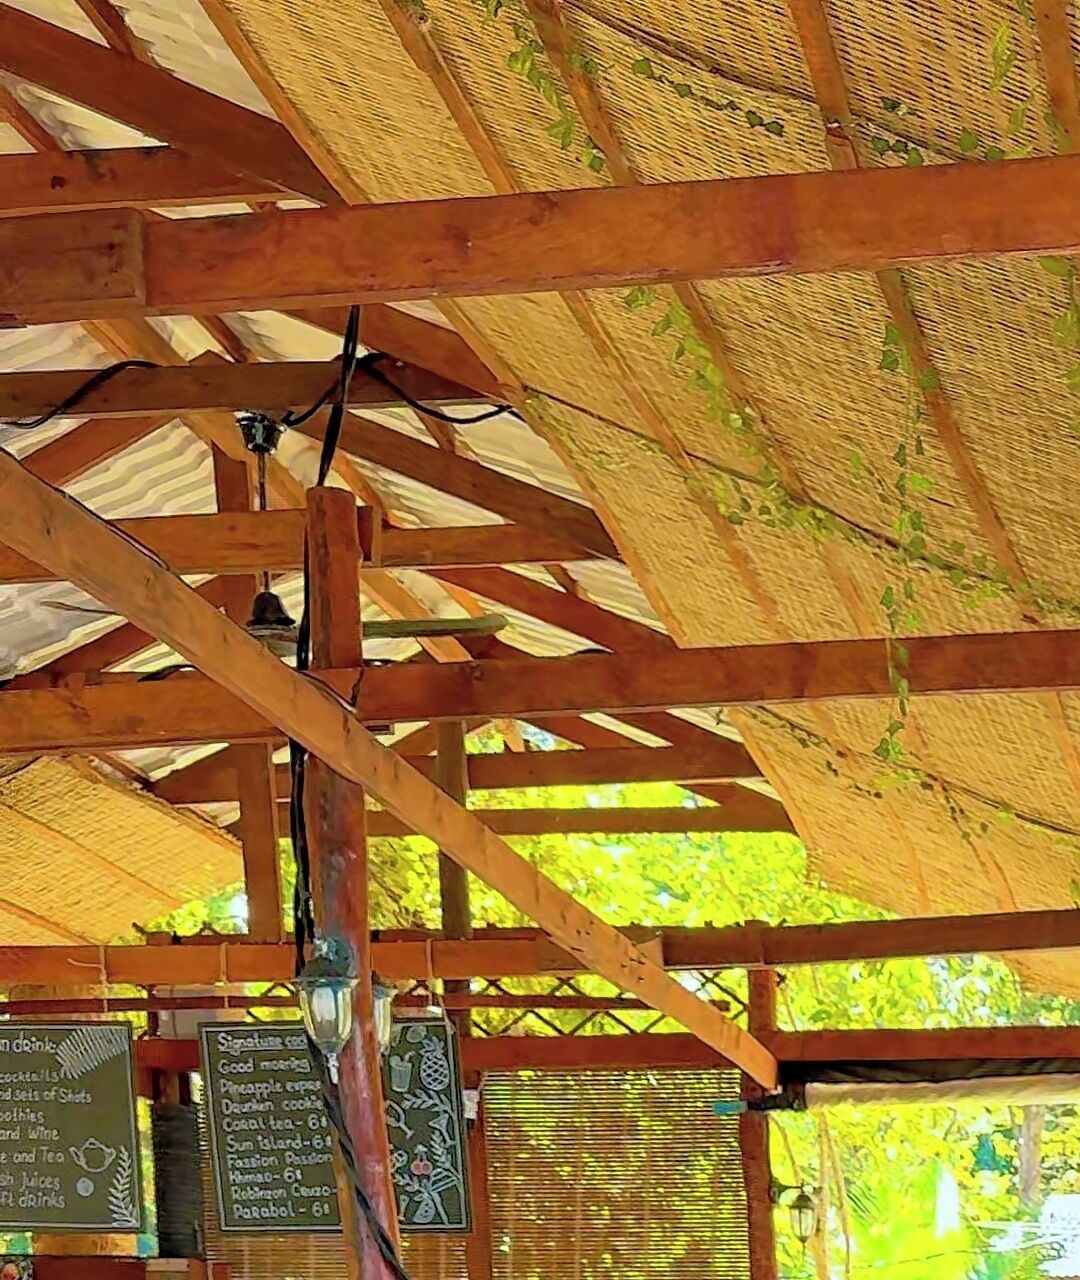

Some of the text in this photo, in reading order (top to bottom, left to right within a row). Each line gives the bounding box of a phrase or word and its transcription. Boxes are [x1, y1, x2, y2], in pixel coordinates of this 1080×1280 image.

[217, 1032, 283, 1056] Signature
[218, 1058, 255, 1074] Good
[220, 1079, 284, 1099] Pineapple
[225, 1134, 254, 1153] Sun
[13, 1148, 37, 1163] and
[39, 1146, 65, 1163] Tea
